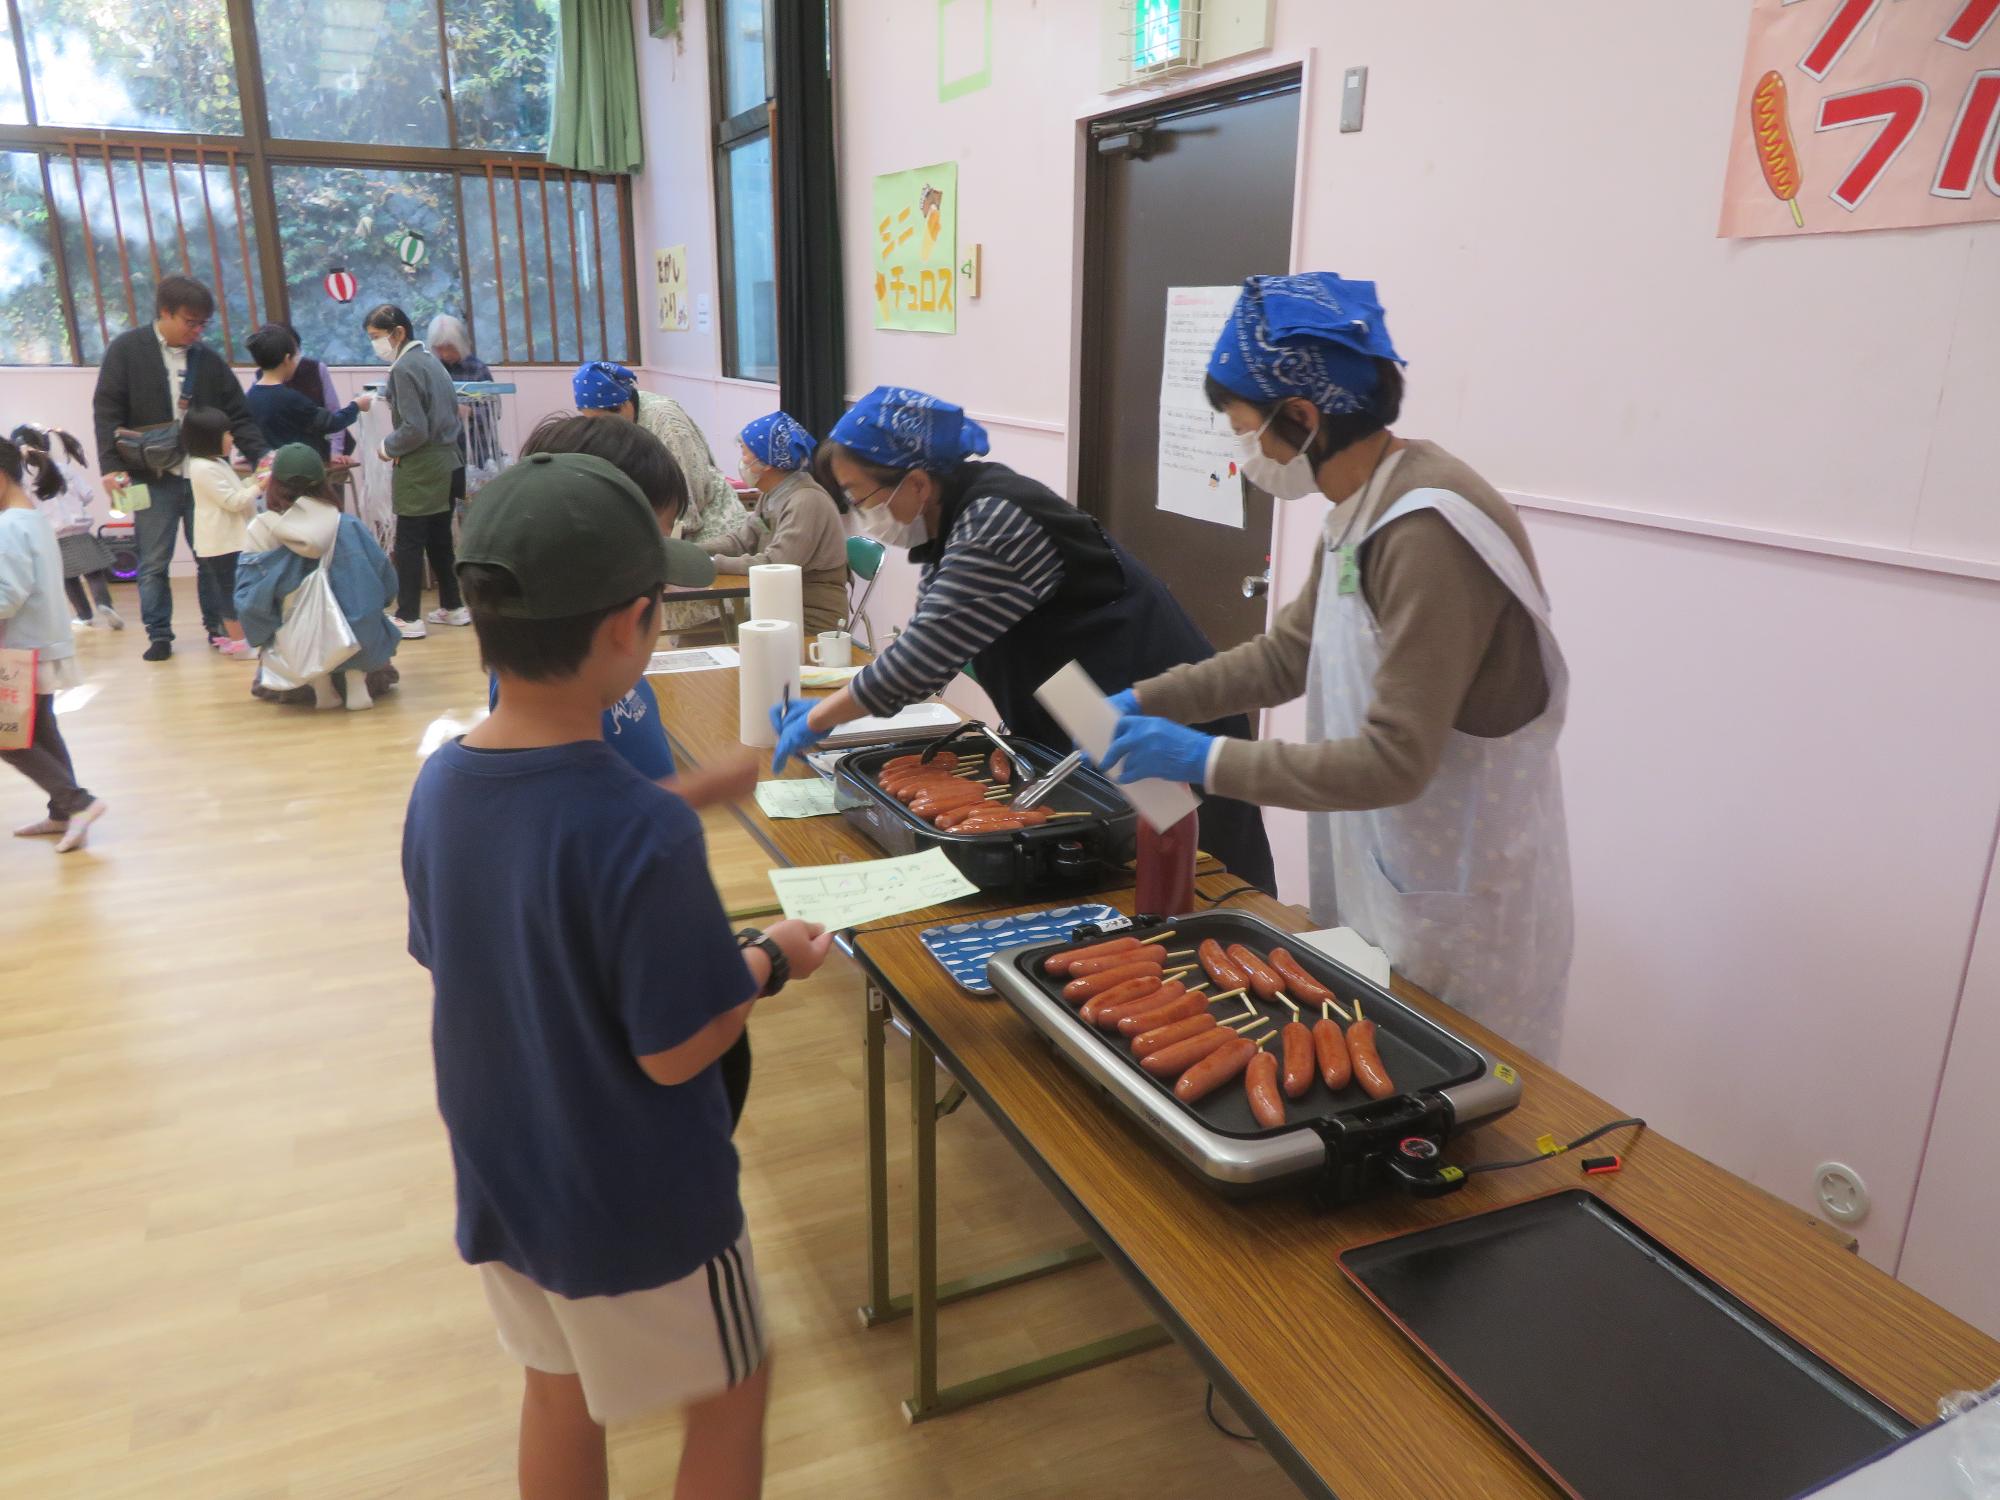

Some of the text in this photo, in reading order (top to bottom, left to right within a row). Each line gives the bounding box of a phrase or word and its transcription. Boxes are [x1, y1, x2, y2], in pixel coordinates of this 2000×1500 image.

[879, 207, 913, 262] ミニ
[889, 265, 954, 313] チュロス
